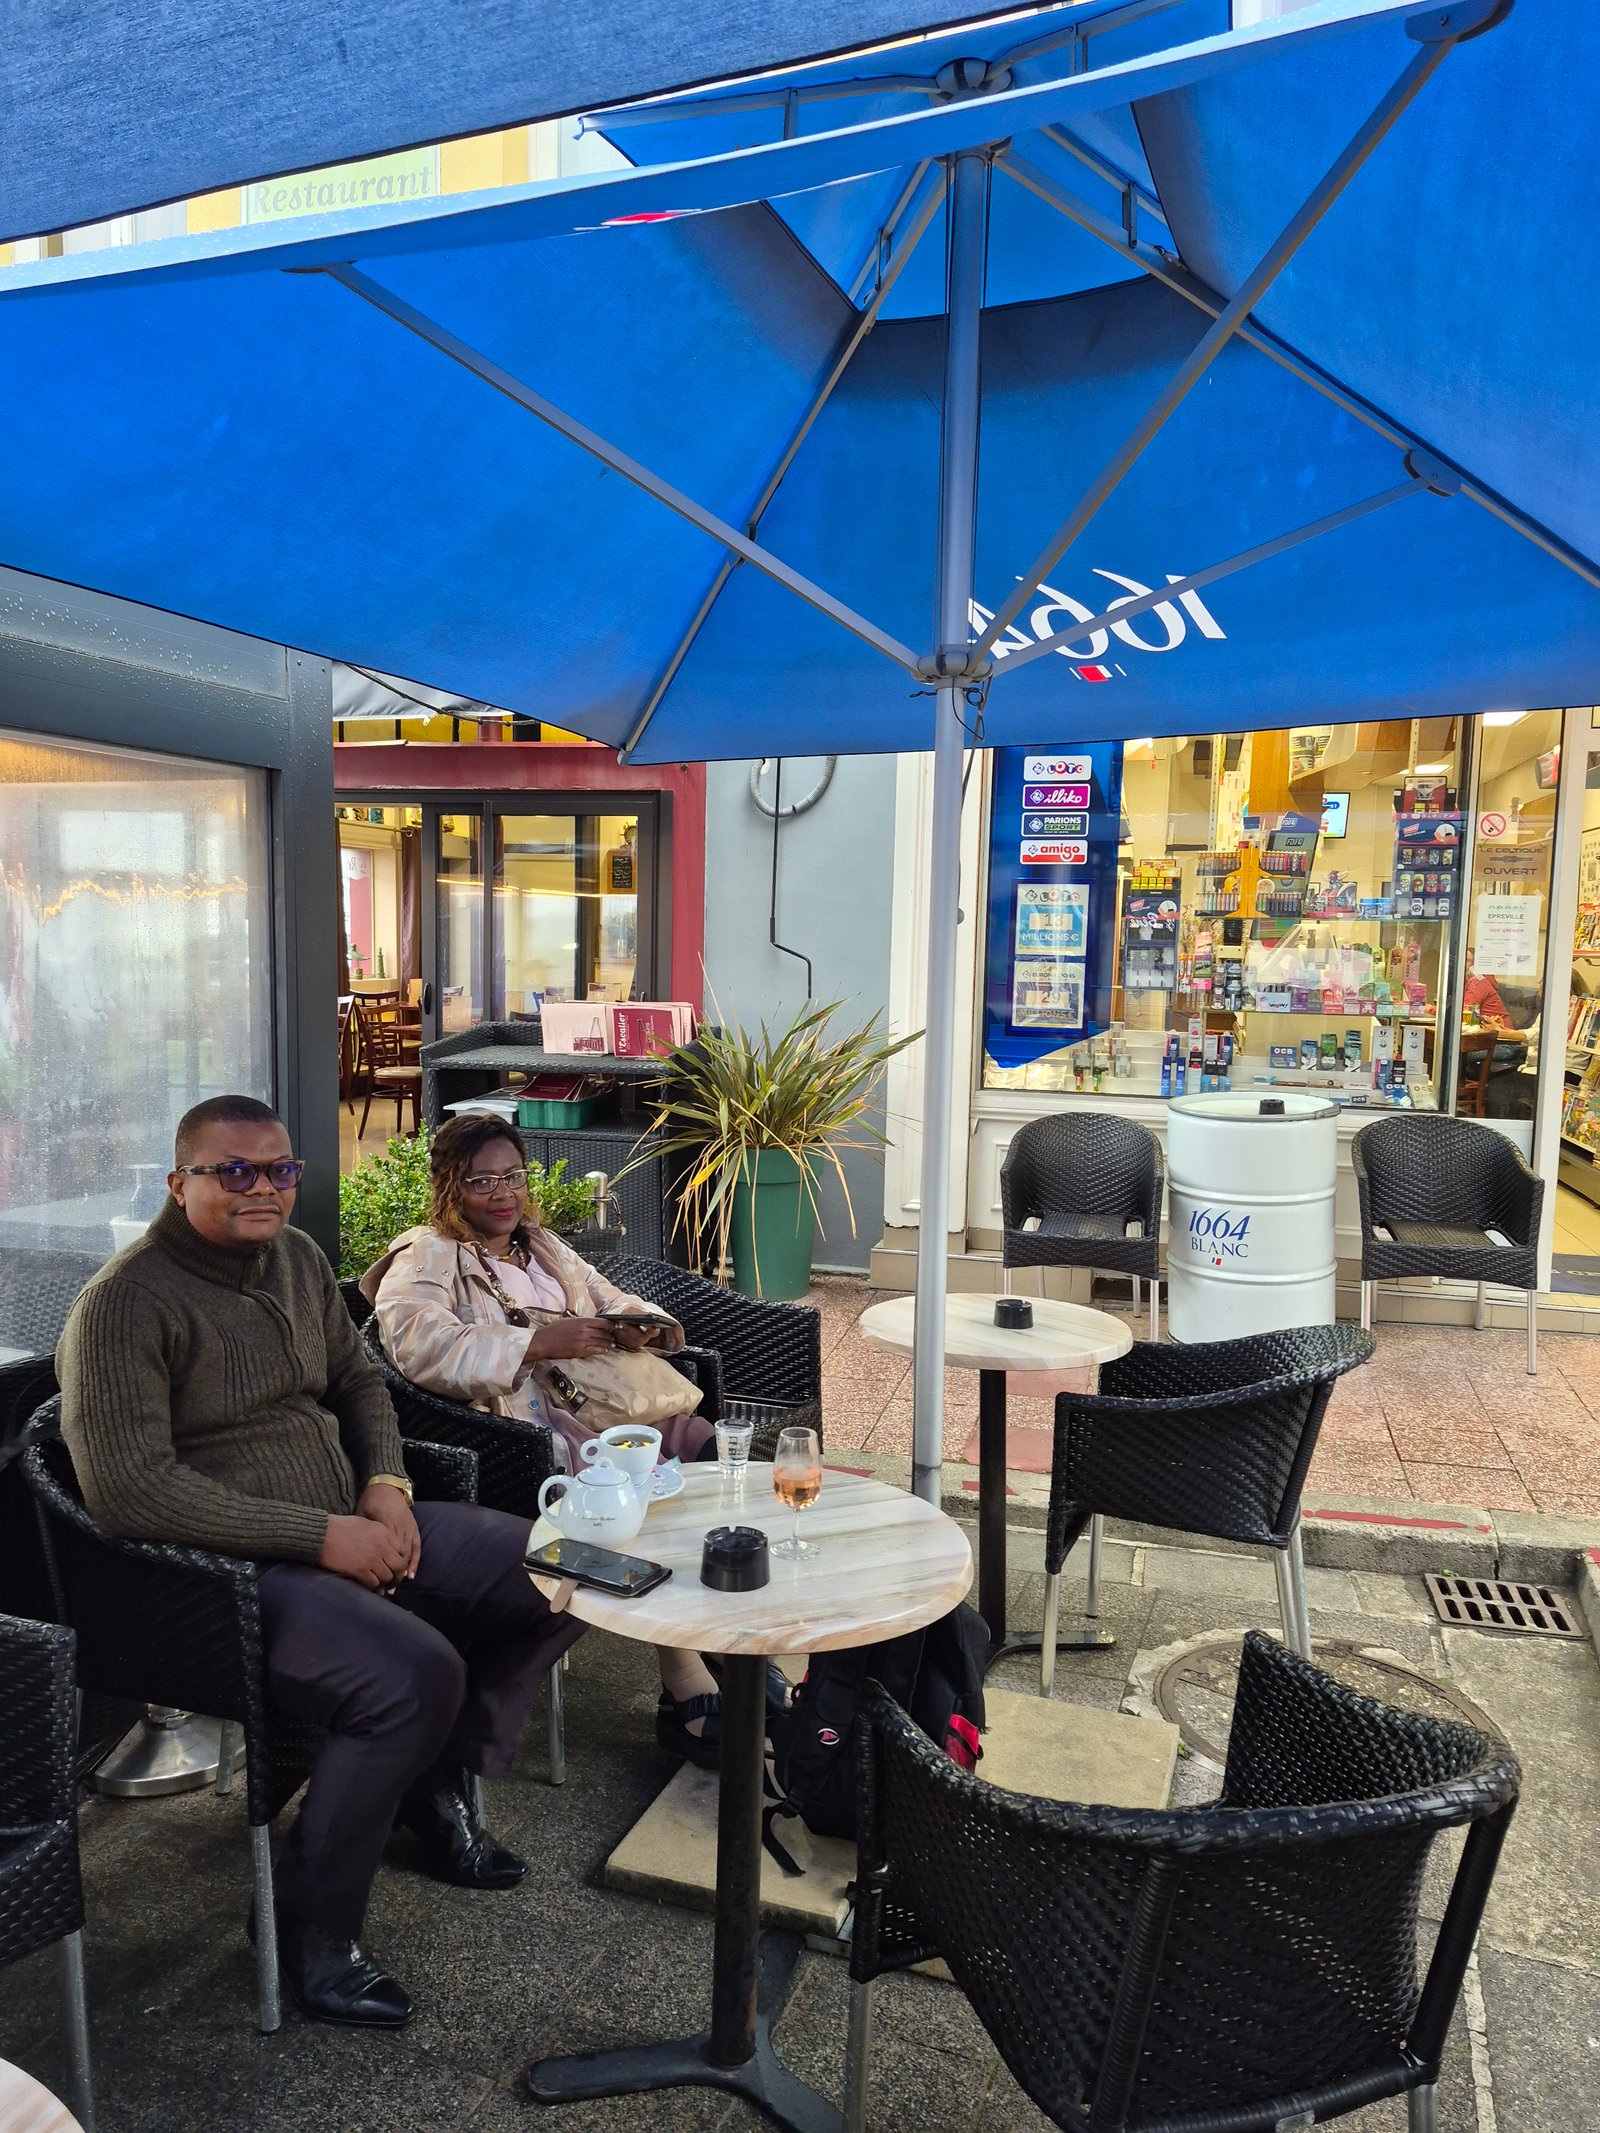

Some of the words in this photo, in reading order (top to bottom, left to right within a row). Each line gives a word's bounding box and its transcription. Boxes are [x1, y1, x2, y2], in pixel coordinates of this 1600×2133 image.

[253, 167, 433, 215] Restaurant
[1047, 761, 1084, 774] LOTO
[1043, 789, 1082, 804] illiko
[1040, 843, 1080, 860] amigo
[1483, 867, 1537, 875] OUVERT
[1041, 991, 1061, 1004] 29
[1188, 1208, 1250, 1241] 1664
[1191, 1236, 1249, 1258] BLANC
